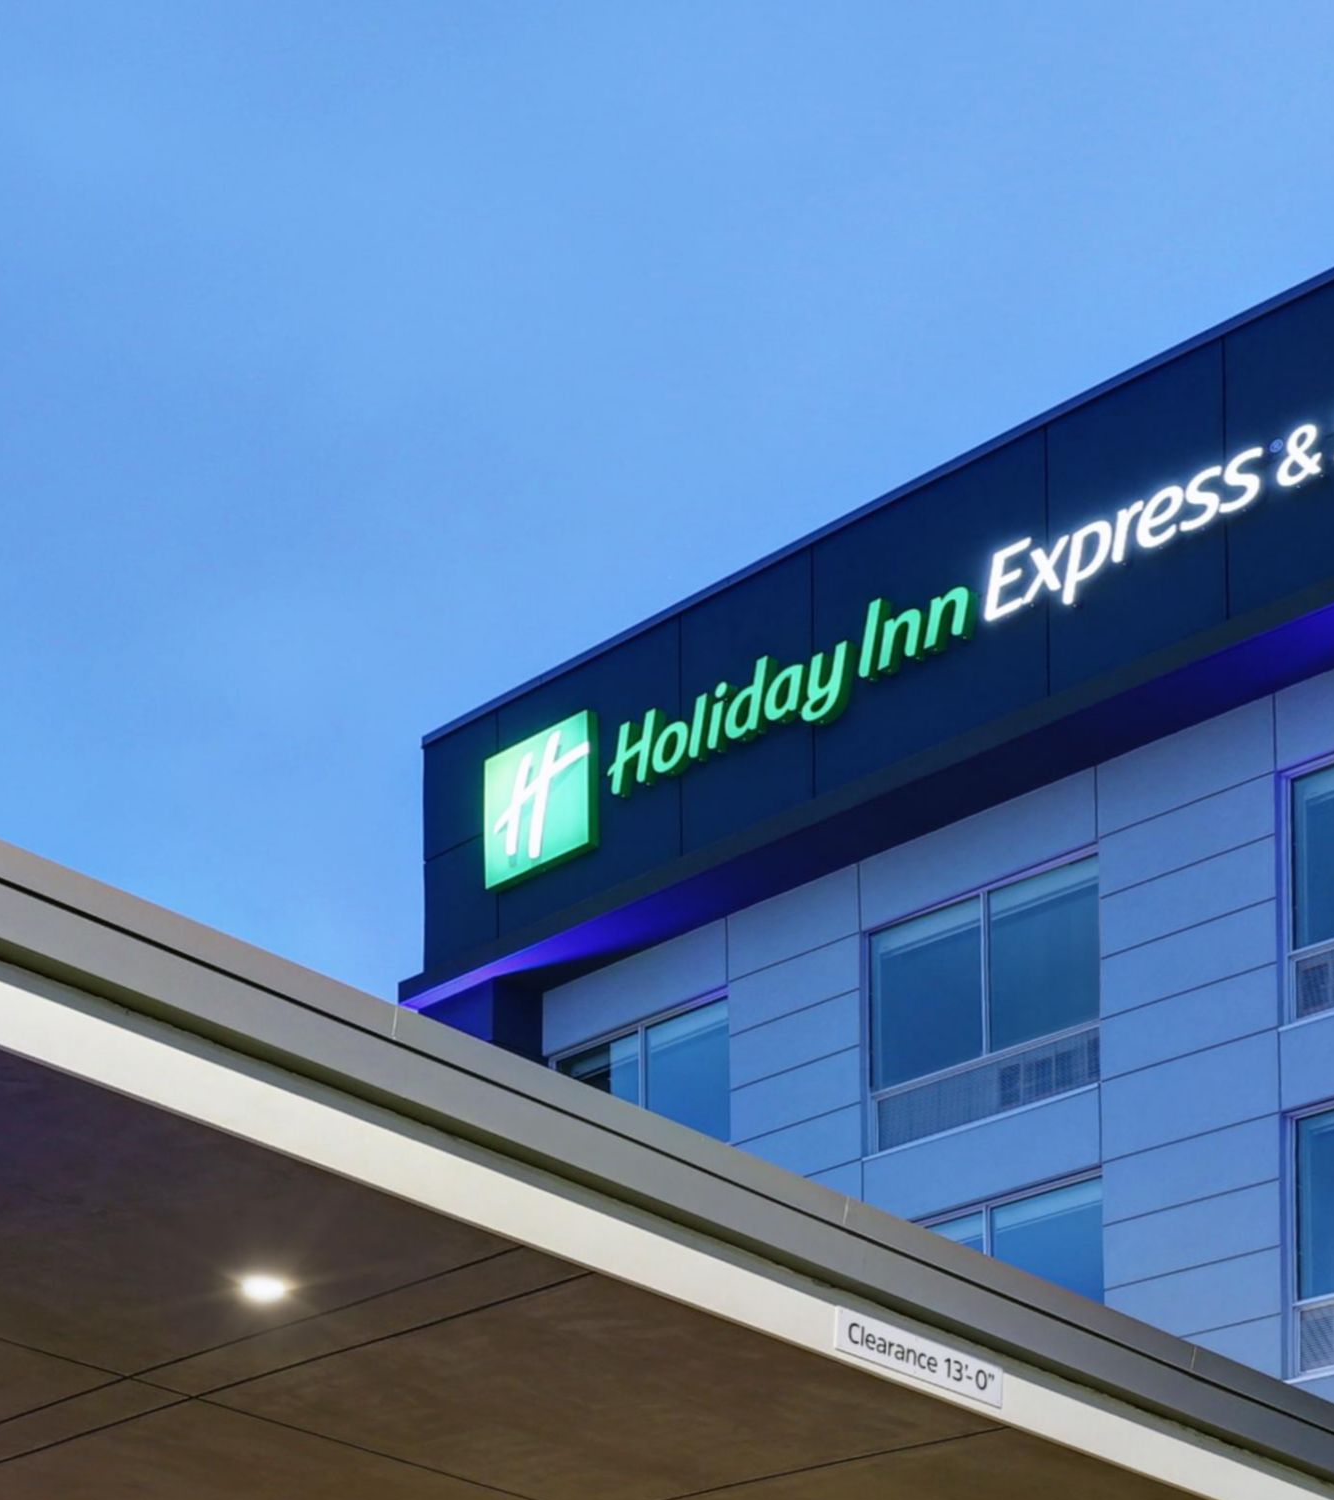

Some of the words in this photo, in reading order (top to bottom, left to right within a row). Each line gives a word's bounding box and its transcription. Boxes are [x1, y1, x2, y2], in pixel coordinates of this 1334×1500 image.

[607, 640, 851, 796] Holiday
[858, 586, 971, 679] Inn
[983, 446, 1264, 622] Express
[1276, 423, 1322, 488] &
[848, 1322, 938, 1374] Clearance
